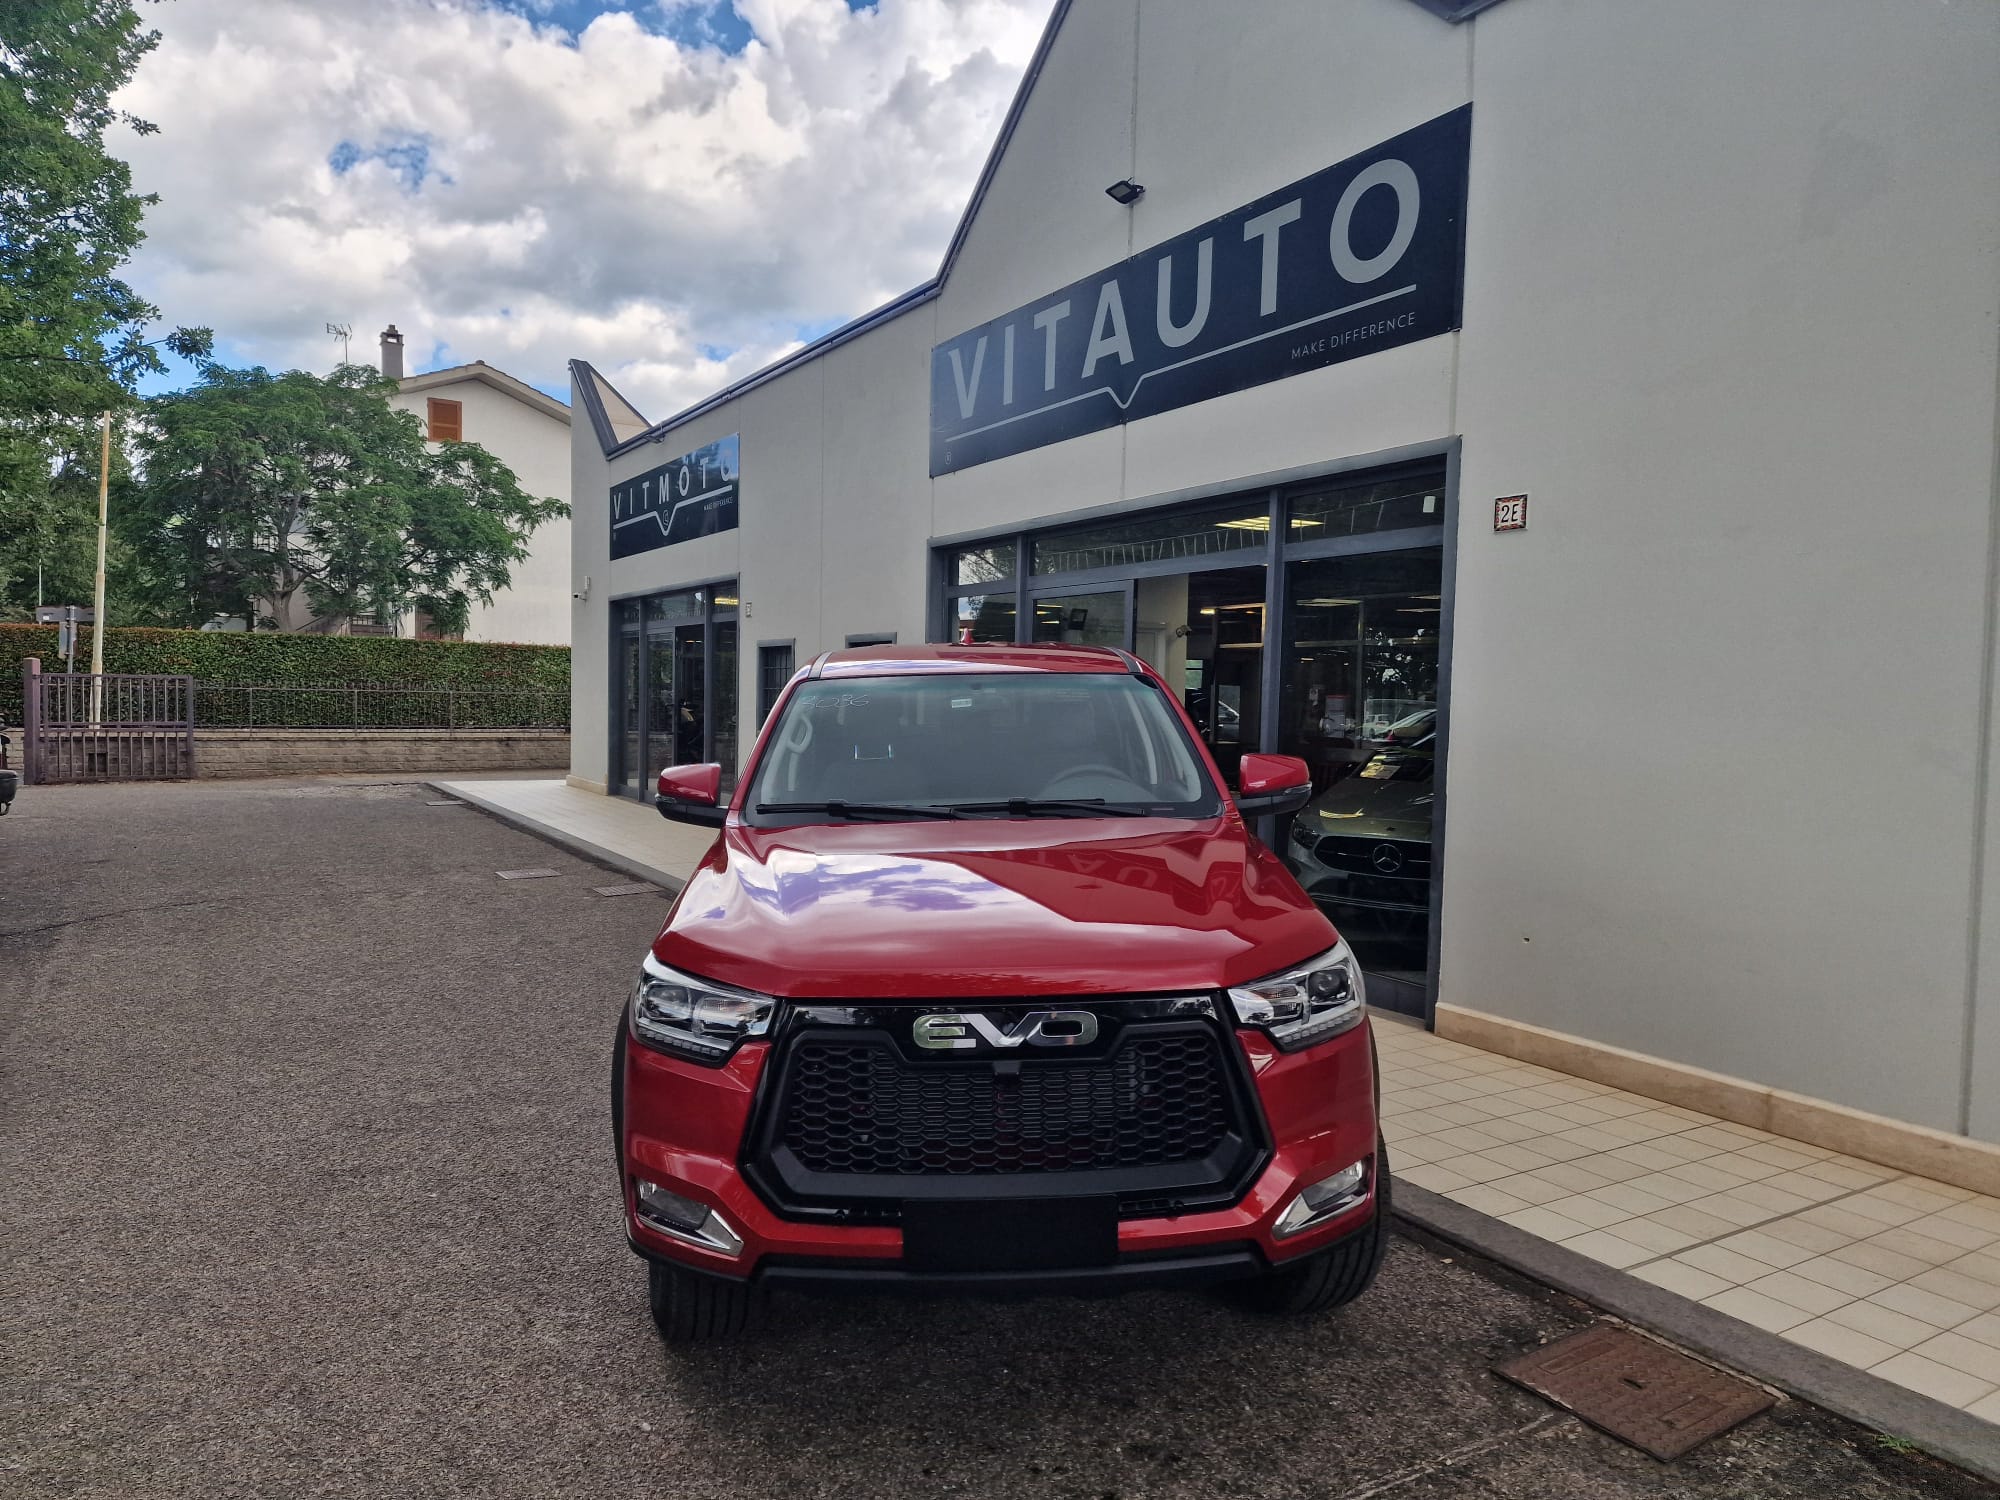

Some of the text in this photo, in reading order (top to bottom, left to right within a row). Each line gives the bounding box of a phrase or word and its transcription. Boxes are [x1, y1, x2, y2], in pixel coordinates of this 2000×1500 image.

[948, 159, 1420, 419] VITAUTO
[1291, 312, 1416, 359] MAKE DIFFERENCE
[1501, 503, 1520, 523] 2E
[913, 1011, 1099, 1049] EVO
